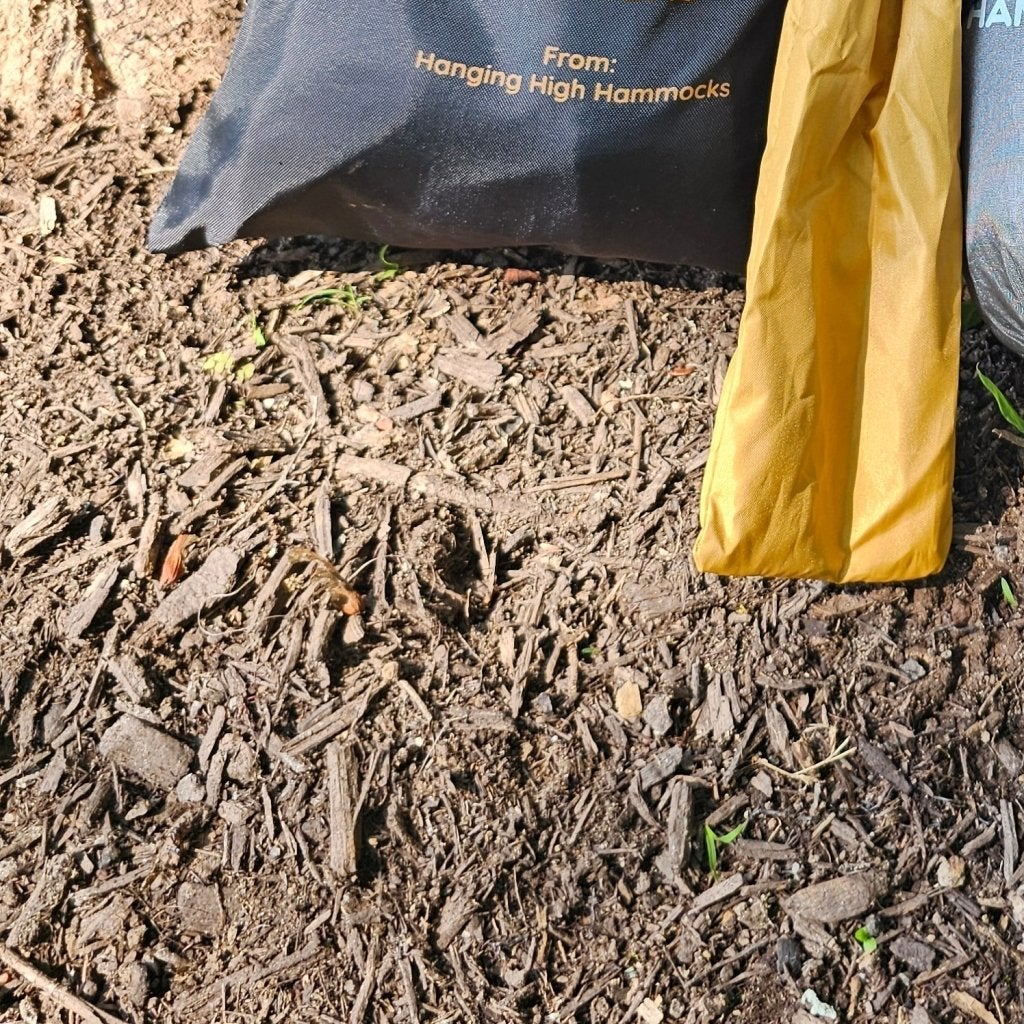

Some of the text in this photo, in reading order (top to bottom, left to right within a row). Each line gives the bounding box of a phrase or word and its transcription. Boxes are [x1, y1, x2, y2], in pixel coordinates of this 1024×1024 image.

[415, 49, 731, 104] Hanging High Hammocks
[542, 45, 618, 73] From:
